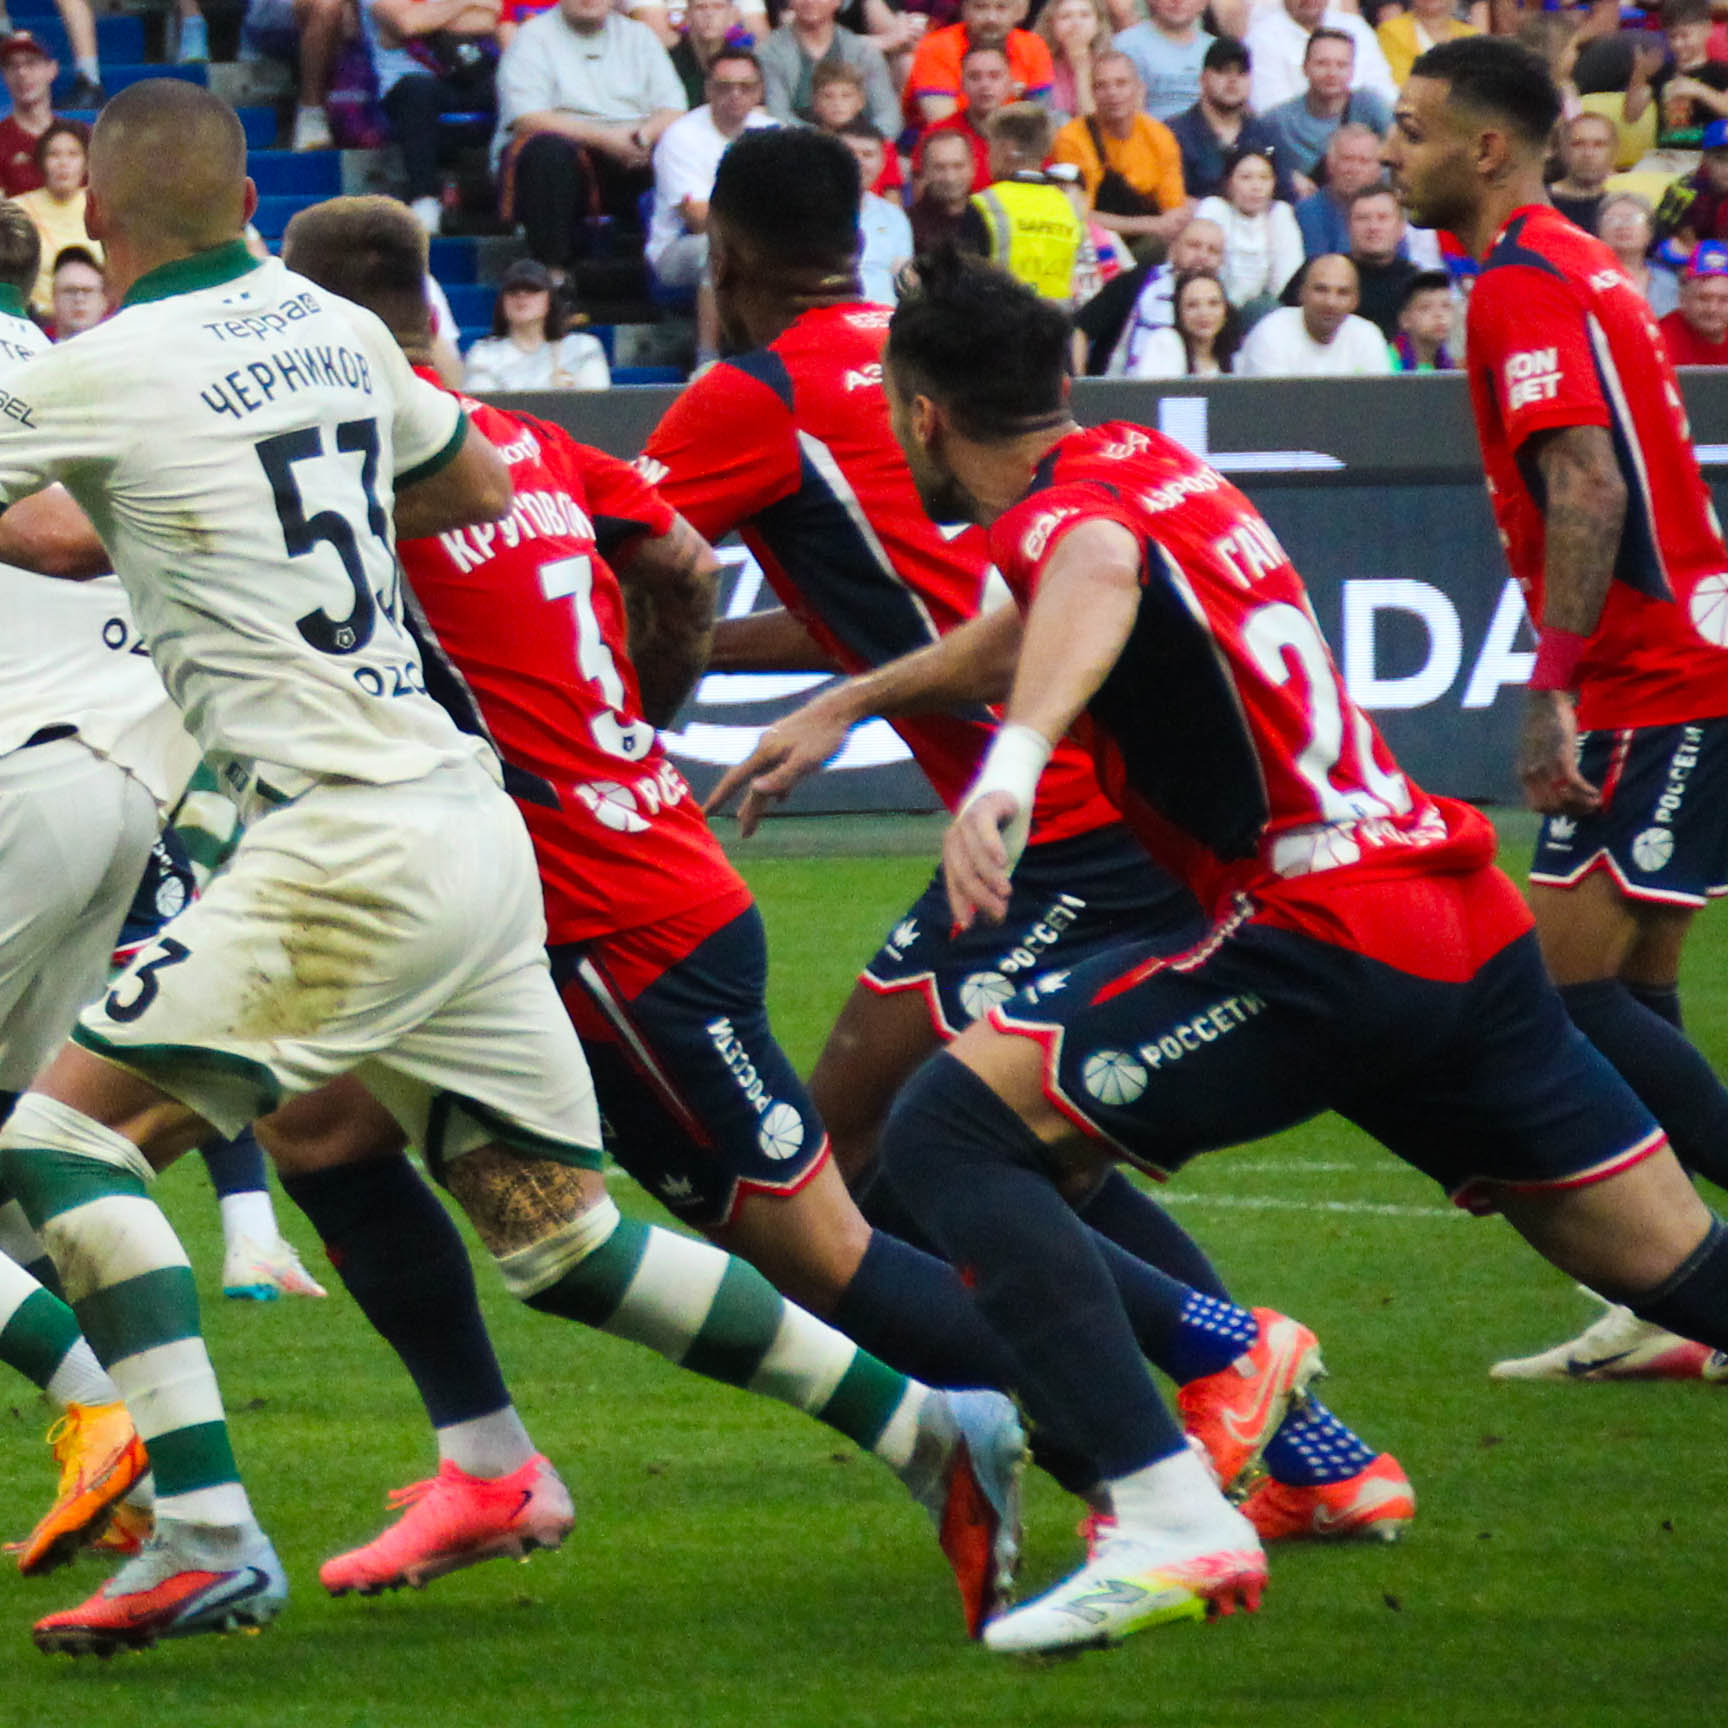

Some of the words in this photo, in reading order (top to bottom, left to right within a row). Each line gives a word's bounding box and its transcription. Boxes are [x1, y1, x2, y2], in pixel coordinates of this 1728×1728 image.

[200, 346, 373, 421] ЧЕРНИКОВ
[1342, 576, 1541, 710] DA
[1139, 992, 1268, 1070] РОССЕТИ
